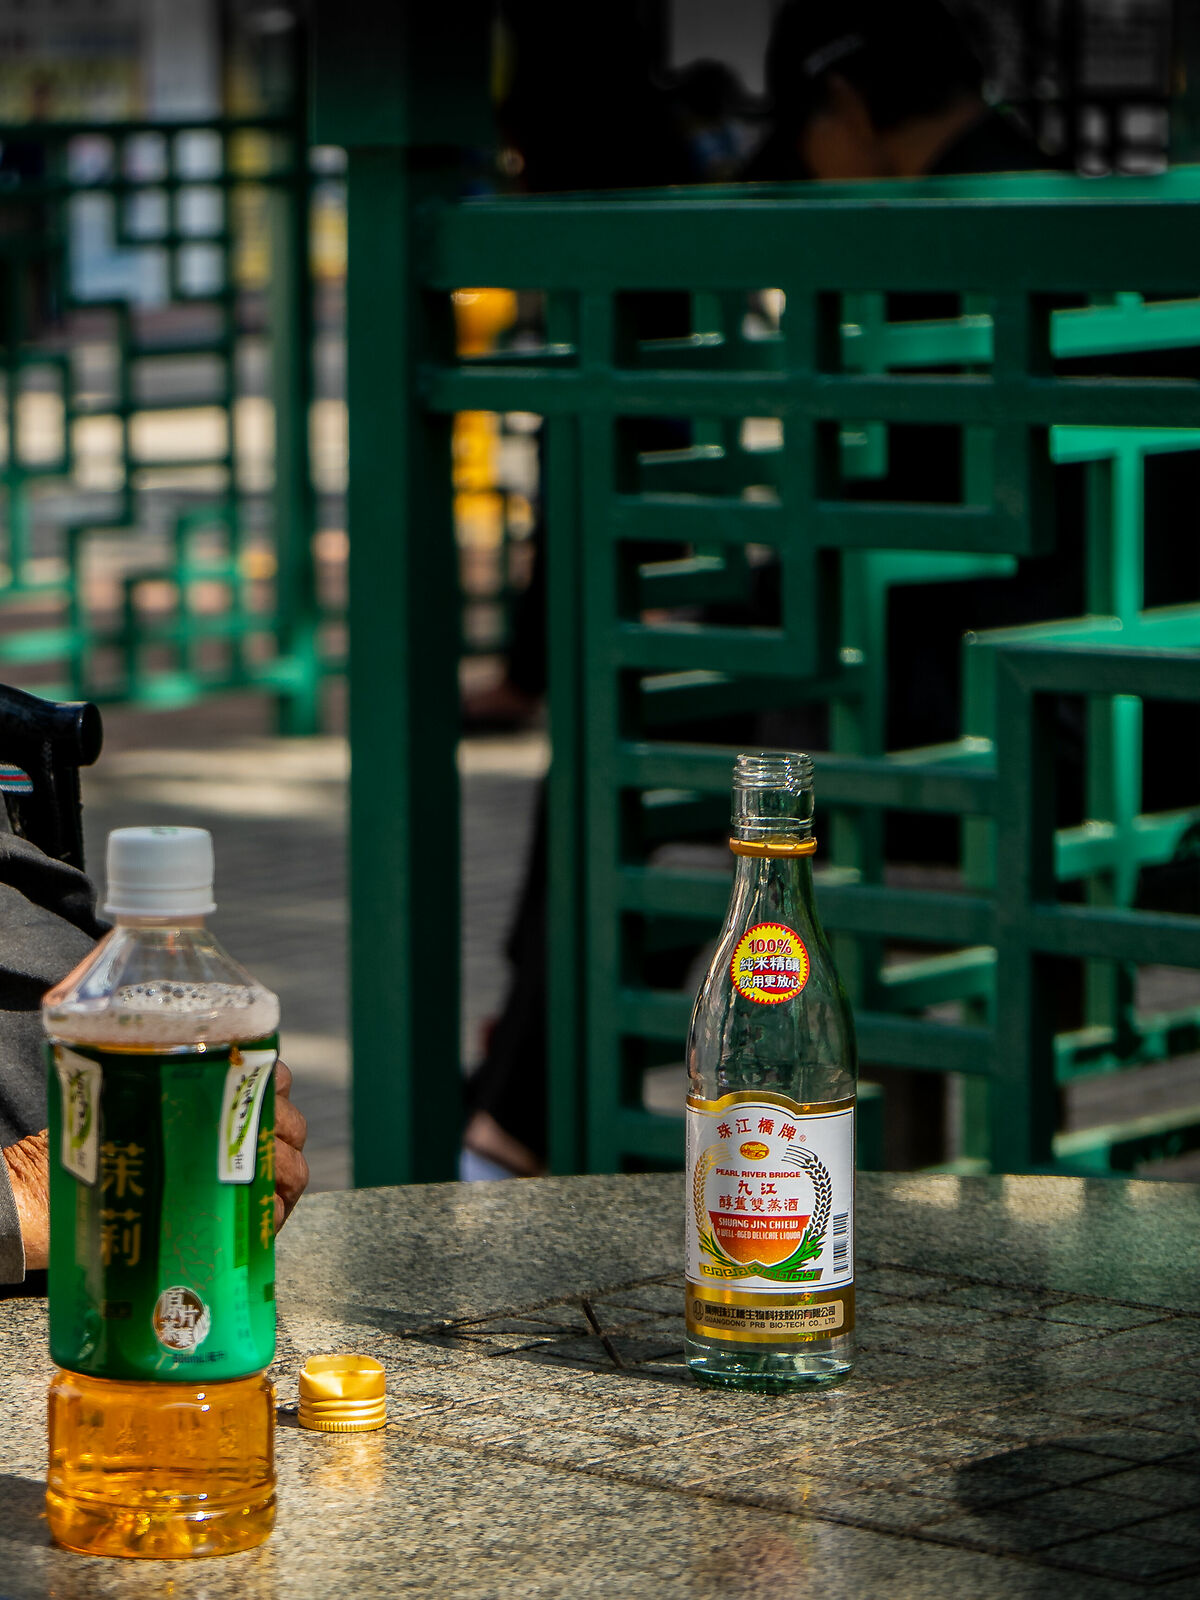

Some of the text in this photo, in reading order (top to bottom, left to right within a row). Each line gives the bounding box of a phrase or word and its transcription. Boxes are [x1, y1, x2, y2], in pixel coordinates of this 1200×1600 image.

[748, 938, 793, 954] 100%
[739, 974, 801, 989] 飲用更放心
[717, 1117, 797, 1142] 珠江橋牌
[716, 1168, 801, 1179] PEARL RIVER BRIDGE
[738, 1180, 778, 1196] 九江
[99, 1142, 145, 1267] 茉莉
[718, 1217, 799, 1229] SHUANG JIN CHIEW
[721, 1230, 751, 1240] WELL-AGED
[752, 1231, 779, 1240] DELICATE
[780, 1231, 801, 1240] LIQUOR
[704, 1315, 746, 1328] GUANGDONG
[749, 1321, 766, 1329] PRB
[769, 1321, 805, 1329] BIO-TECH
